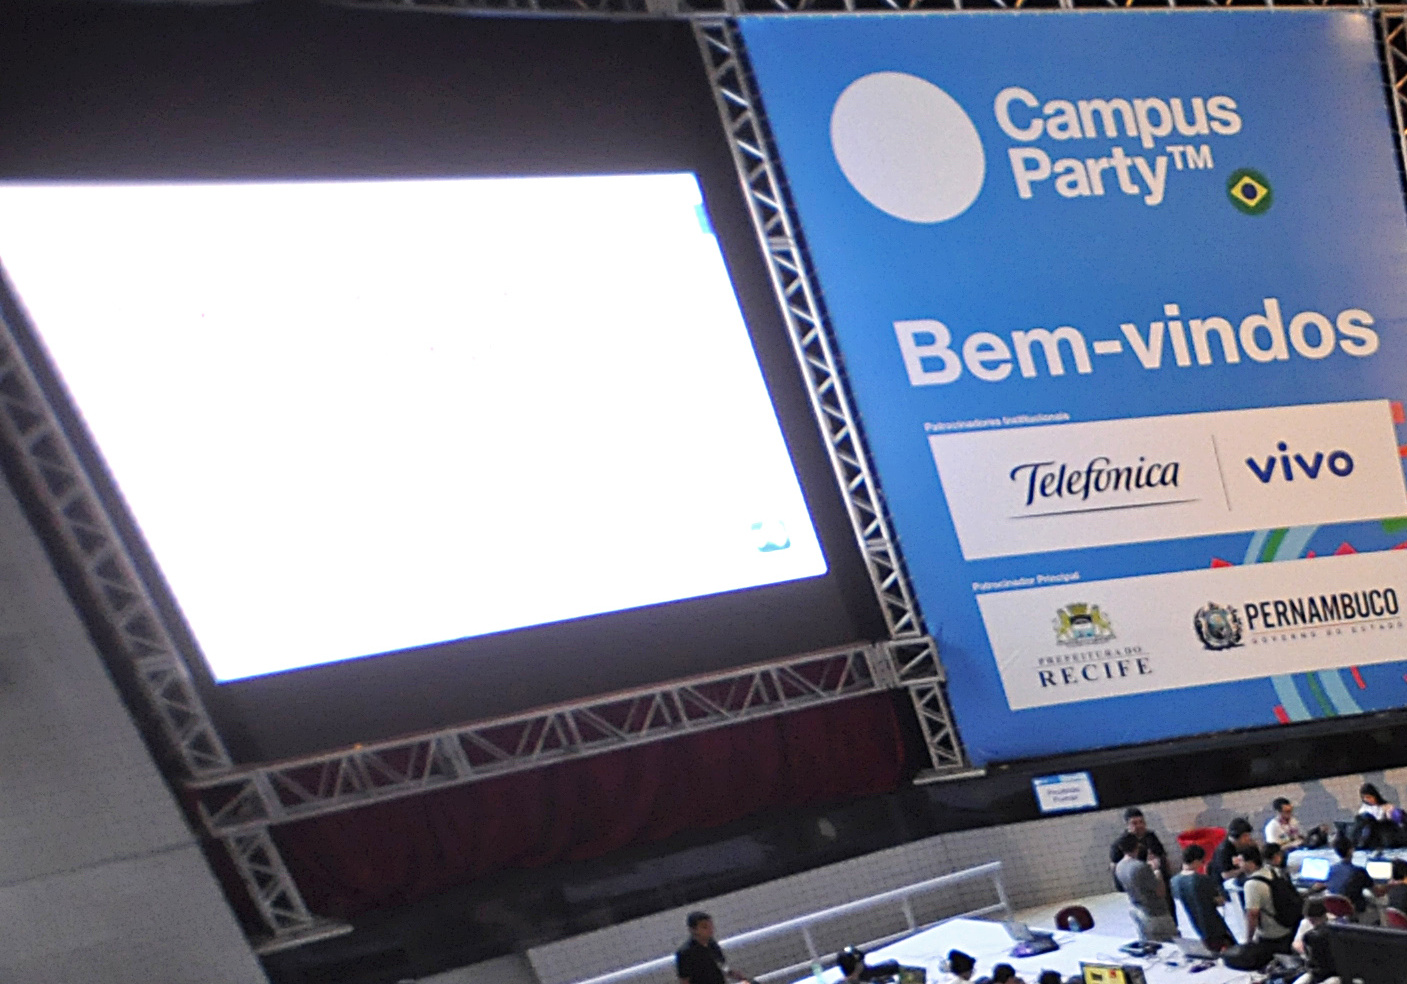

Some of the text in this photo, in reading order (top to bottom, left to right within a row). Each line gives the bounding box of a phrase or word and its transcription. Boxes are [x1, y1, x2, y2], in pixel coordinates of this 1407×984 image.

[994, 87, 1242, 149] Campus
[894, 298, 1379, 387] Bem-vindos
[1246, 441, 1354, 484] vivo
[972, 571, 1080, 591] Patrocinador Principal
[1244, 588, 1399, 630] PERNAMBUCO
[1038, 657, 1153, 688] RECIFE
